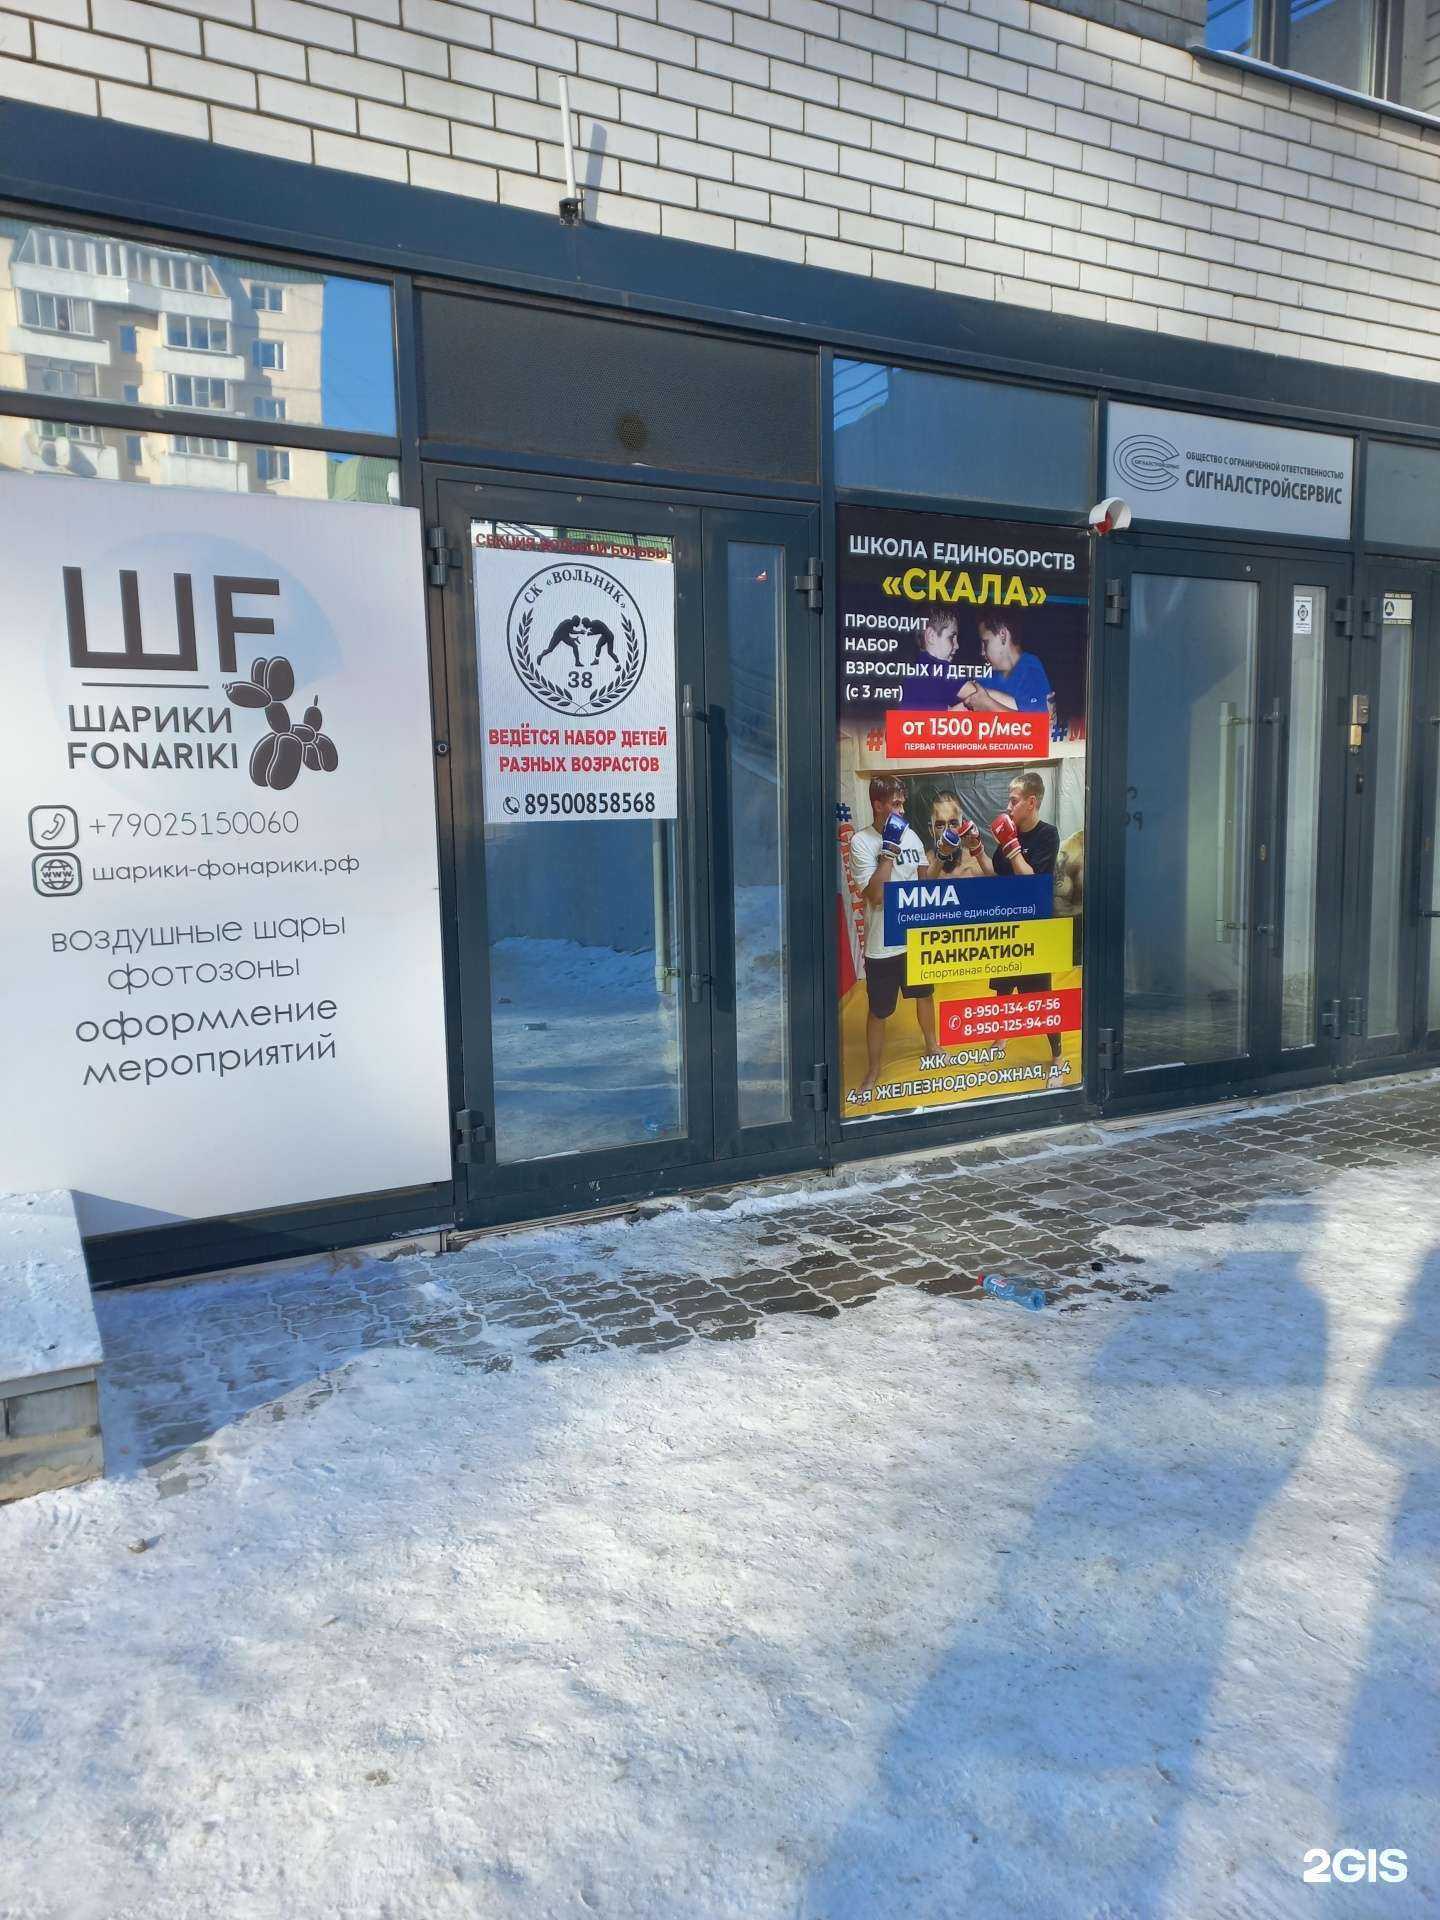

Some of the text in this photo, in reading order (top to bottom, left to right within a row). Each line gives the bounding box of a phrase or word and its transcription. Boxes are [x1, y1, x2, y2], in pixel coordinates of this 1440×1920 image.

[1185, 450, 1223, 464] ОБЩЕСТВО
[1229, 457, 1280, 472] ОГРАНИЧЕННОЙ
[1281, 464, 1344, 479] ОТВЕТСТВЕННОСТЬЮ
[1185, 469, 1343, 504] СИГНАЛСТРОЙСЕРВИС
[849, 534, 1076, 571] ШКОЛА ЕДИНОБОРСТВ
[524, 569, 626, 608] СК «ВОЛЬНИК»
[882, 567, 1047, 607] «СКАЛА»
[845, 613, 929, 632] ПРОВОДИТ
[845, 638, 899, 652] НАБОР
[568, 671, 593, 690] 38
[845, 661, 993, 679] ВЗРОСЛЫХ И ДЕТЕЙ
[845, 685, 904, 701] (с 3 лет)
[68, 704, 232, 734] ШАРИКИ
[902, 715, 1032, 740] от 1500 р/мес
[488, 723, 668, 748] ВЕДЁТСЯ НАБОР ДЕТЕЙ
[904, 742, 1034, 751] ПЕРВАЯ ТРЕНИРОВКА БЕСПЛАТНО
[67, 742, 238, 770] FONARIKI
[499, 755, 660, 773] РАЗНЫХ ВОЗРАСТОВ
[524, 792, 656, 815] 89500858568
[89, 810, 299, 838] +79025150060
[93, 854, 360, 884] шарики-фонарики.рф
[898, 885, 960, 909] ММА
[897, 903, 1036, 924] (смешанные единоборства)
[51, 915, 346, 955] воздушные шары
[920, 925, 1020, 946] ГРЭППЛИНГ
[920, 942, 1035, 965] ПАНКРАТИОН
[108, 958, 300, 995] фотозоны
[920, 962, 1023, 980] (спортивная борьба)
[964, 997, 1061, 1020] 8-950-134-67-56
[75, 999, 338, 1045] оформление
[964, 1014, 1061, 1036] 8-950-125-94-60
[83, 1032, 337, 1086] мероприятий
[920, 1047, 1006, 1071] ЖК «ОЧАГ»
[846, 1061, 1071, 1105] 4-я ЖЕЛЕЗНОДОРОЖНАЯ, д.4
